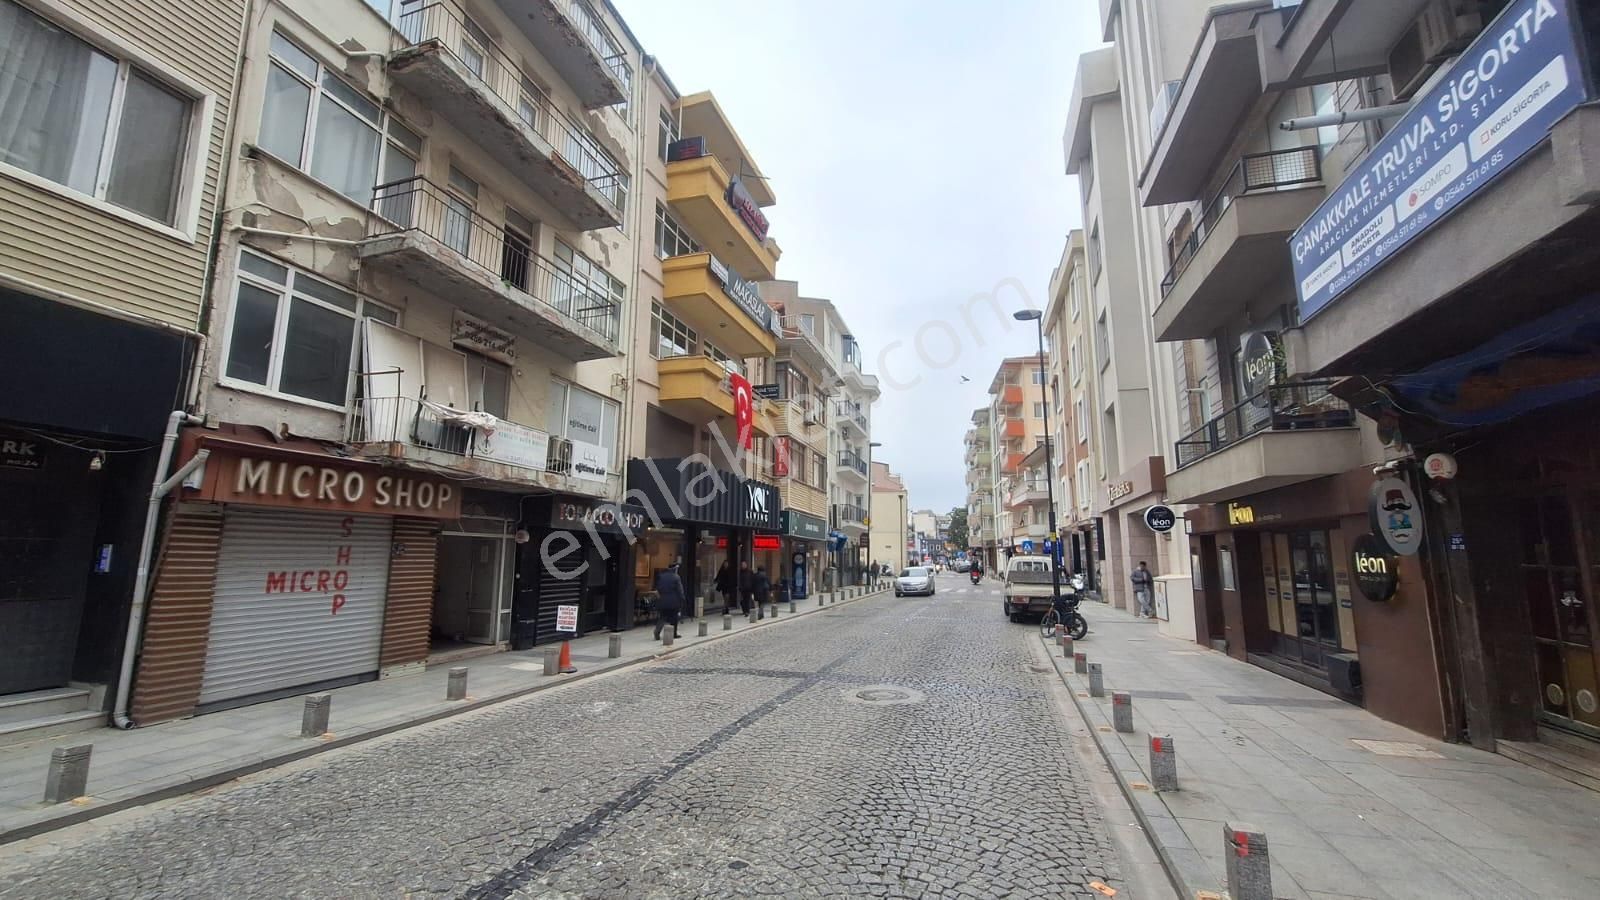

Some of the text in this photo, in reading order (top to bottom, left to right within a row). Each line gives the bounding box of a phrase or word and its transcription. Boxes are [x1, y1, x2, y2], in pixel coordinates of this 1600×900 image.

[1295, 0, 1557, 264] ÇANAKKALE TRUVA SİGORTA
[1433, 123, 1464, 151] LTD.
[1490, 112, 1512, 136] KORU
[1491, 149, 1503, 166] 85
[1420, 163, 1451, 195] SOMPO
[1351, 216, 1383, 249] ANADOLU
[1246, 352, 1272, 383] léon
[237, 458, 451, 510] MICRO SHOP
[1228, 502, 1254, 525] léon
[1355, 552, 1386, 574] léon
[265, 569, 349, 594] MICRO
